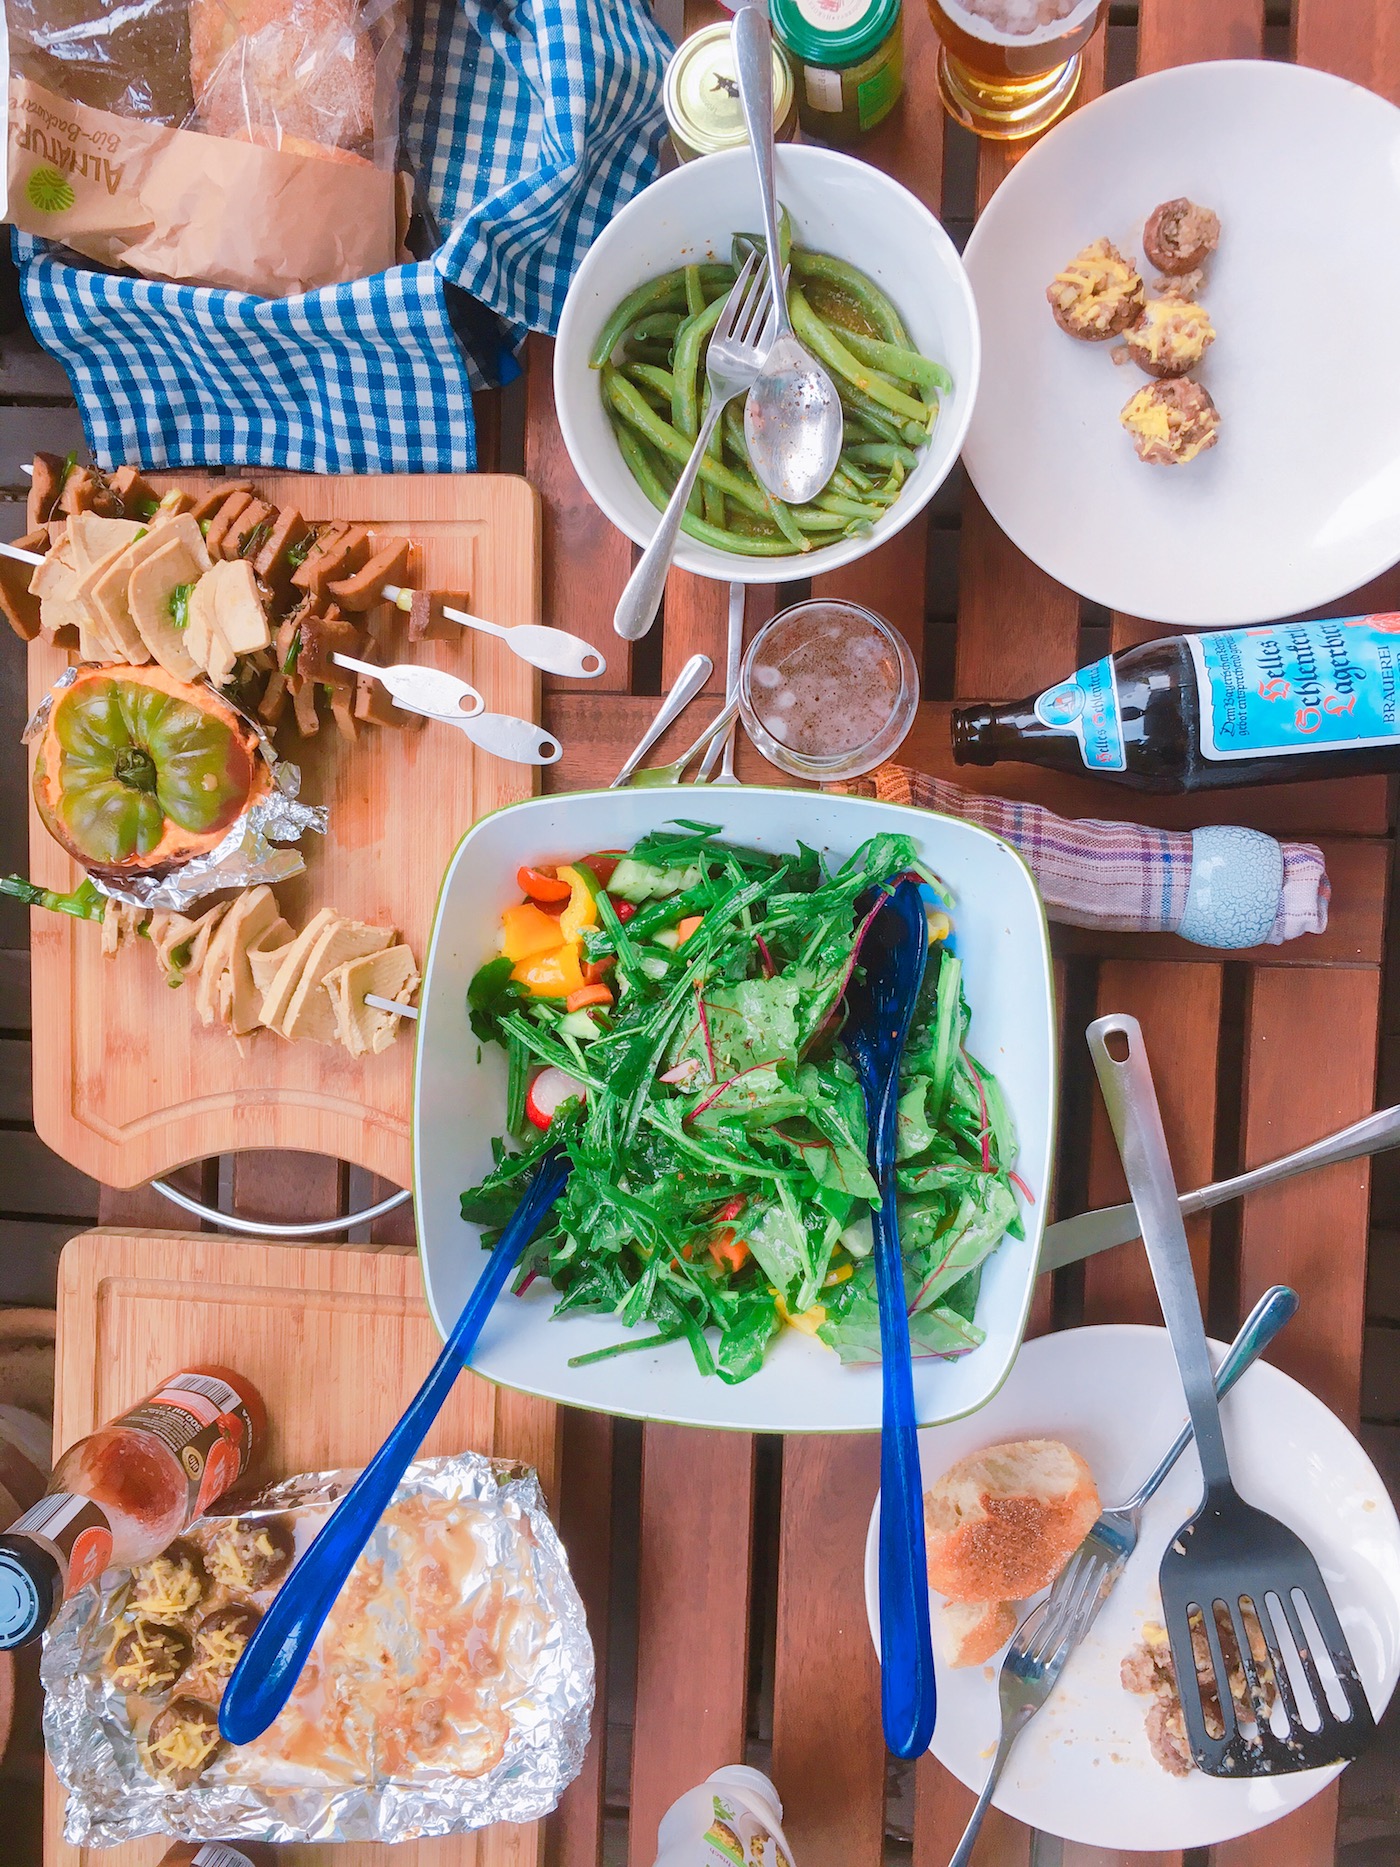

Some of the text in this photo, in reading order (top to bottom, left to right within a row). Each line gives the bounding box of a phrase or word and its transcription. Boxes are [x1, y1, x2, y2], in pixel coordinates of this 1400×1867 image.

[1257, 640, 1290, 702] Helles
[1317, 624, 1366, 717] Lagerbier
[1378, 645, 1395, 724] BRAUEREI
[1220, 707, 1235, 737] Dem
[1096, 730, 1112, 762] Helles
[172, 1406, 186, 1418] ml
[185, 1415, 203, 1432] 300
